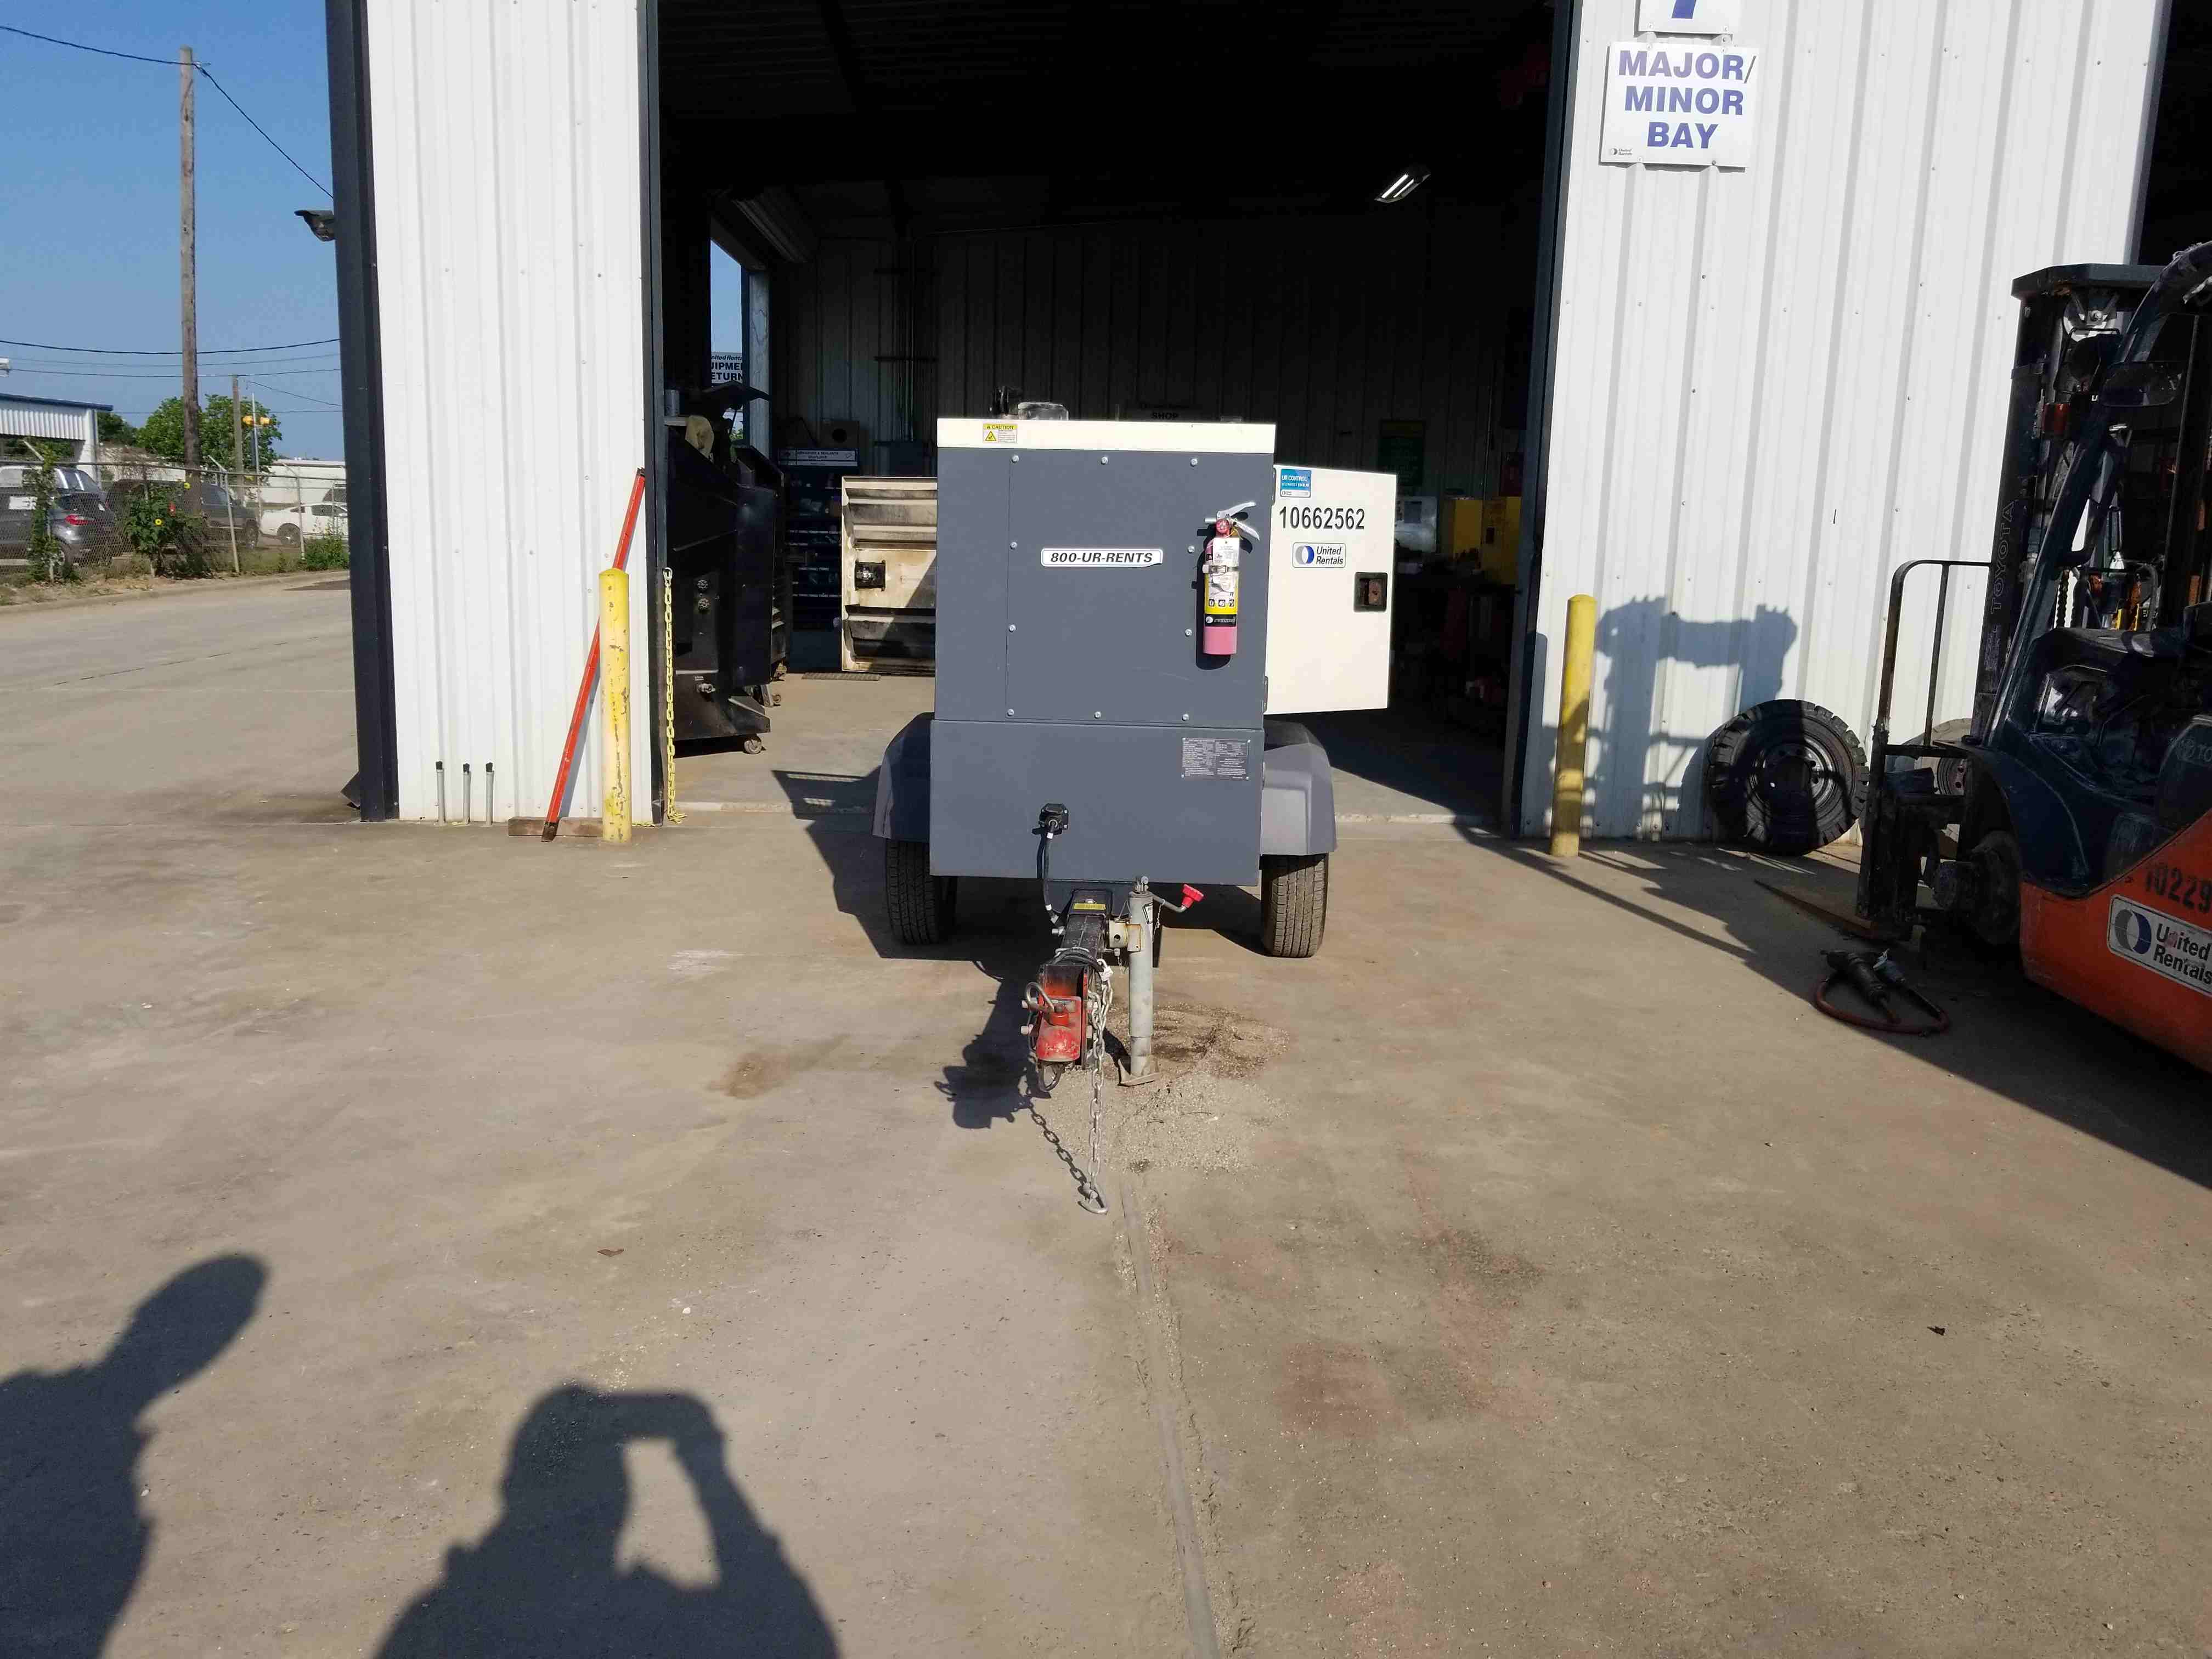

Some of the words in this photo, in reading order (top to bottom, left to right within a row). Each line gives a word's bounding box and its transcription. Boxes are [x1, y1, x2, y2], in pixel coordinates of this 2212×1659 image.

[1618, 50, 1756, 83] MAJOR/
[1625, 86, 1743, 115] MINOR
[1647, 122, 1719, 149] BAY
[1279, 506, 1365, 529] 10662562
[1051, 552, 1153, 563] 800-UR-RENTS
[1316, 546, 1342, 555] United
[1316, 556, 1344, 565] Rentals
[1990, 500, 2015, 614] TOYOTA
